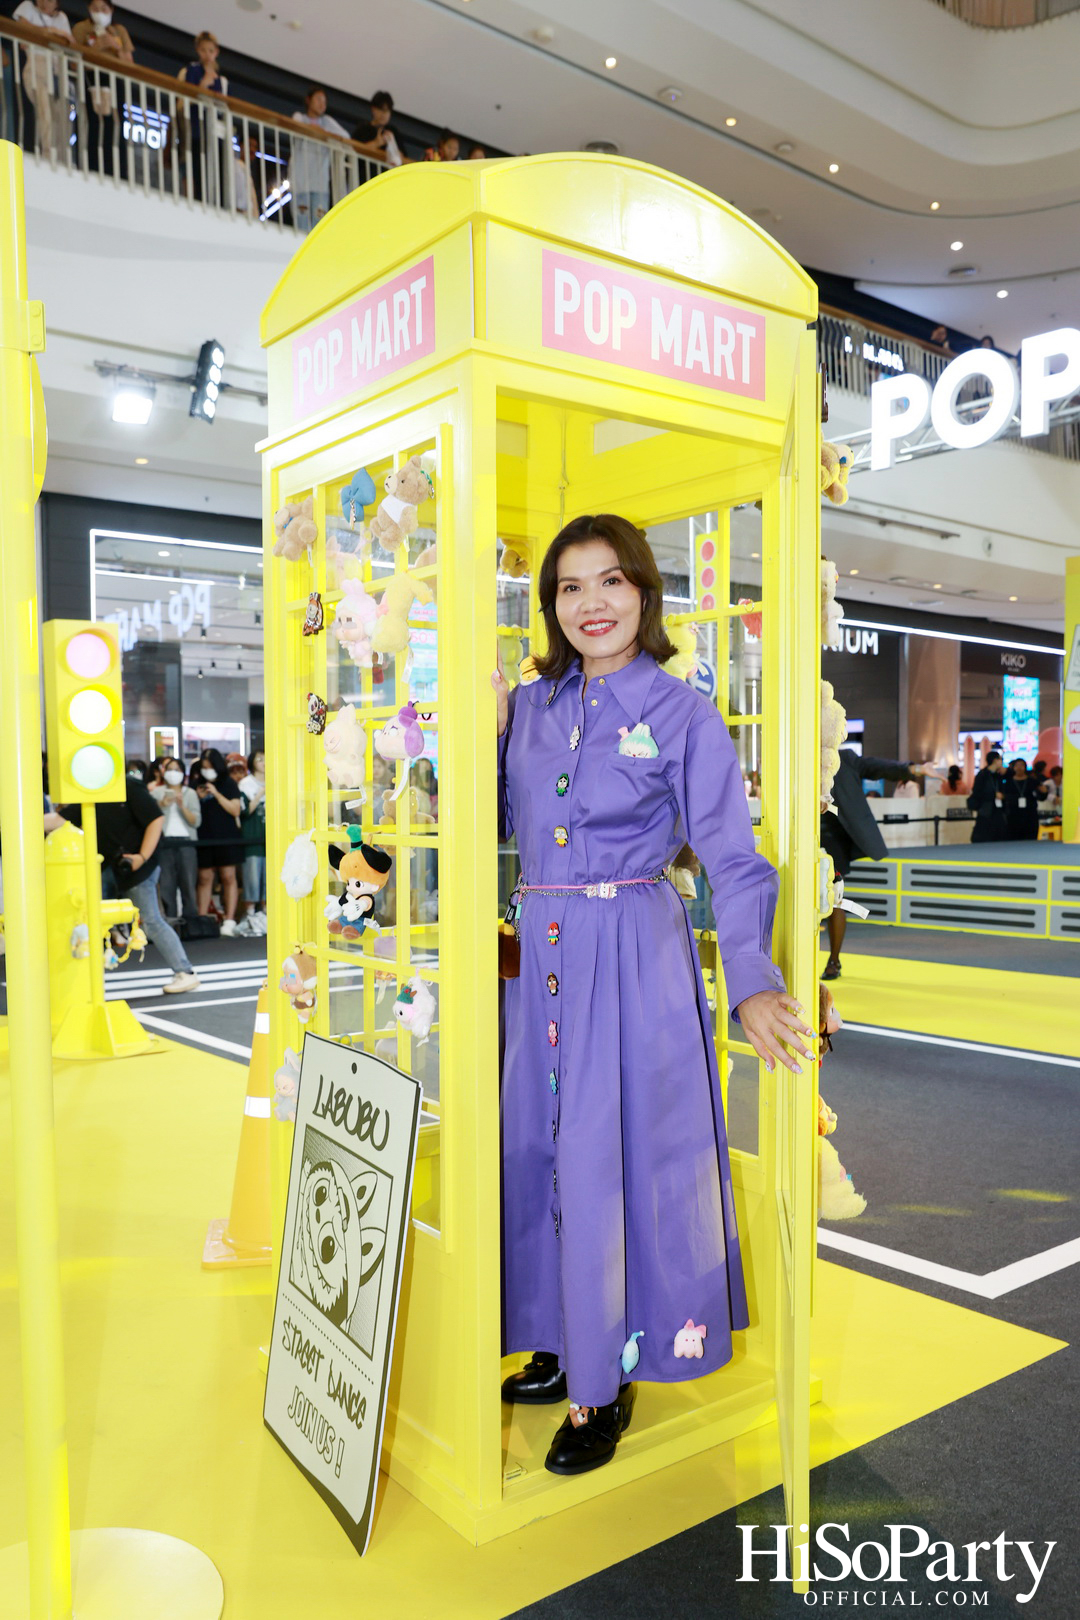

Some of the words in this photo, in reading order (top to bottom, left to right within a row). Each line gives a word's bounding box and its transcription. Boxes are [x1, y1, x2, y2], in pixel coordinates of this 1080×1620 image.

[298, 328, 344, 405] POP
[351, 275, 427, 379] MART
[554, 268, 637, 351] POP
[651, 296, 757, 385] MART
[871, 327, 1080, 471] POP
[1001, 652, 1027, 668] KIKO
[312, 1074, 390, 1151] LABUBU
[282, 1315, 325, 1383] STREET
[327, 1359, 367, 1430] DANCE
